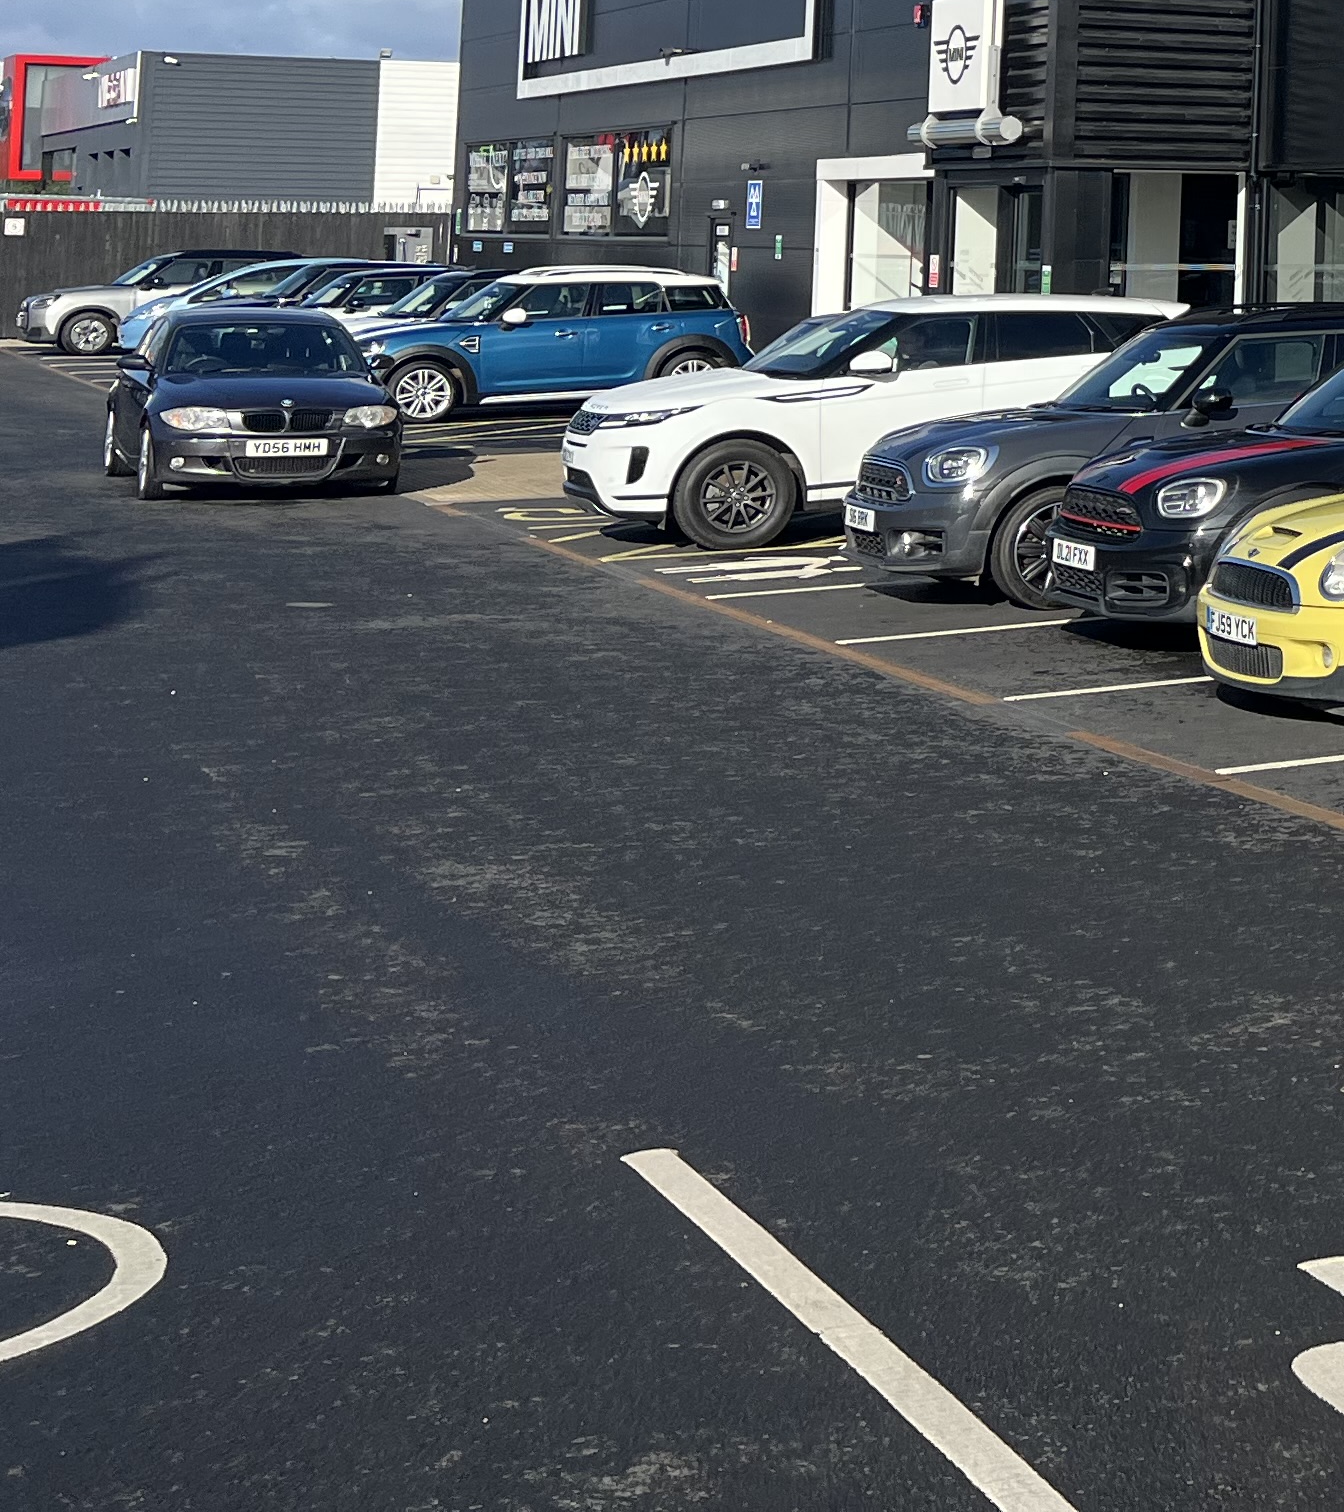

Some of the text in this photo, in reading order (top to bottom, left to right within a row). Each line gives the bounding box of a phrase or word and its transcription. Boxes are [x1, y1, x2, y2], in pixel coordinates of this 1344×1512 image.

[253, 441, 321, 454] YD56 HMH
[1073, 546, 1089, 566] FXX
[1210, 610, 1255, 641] FJ59 YCK
